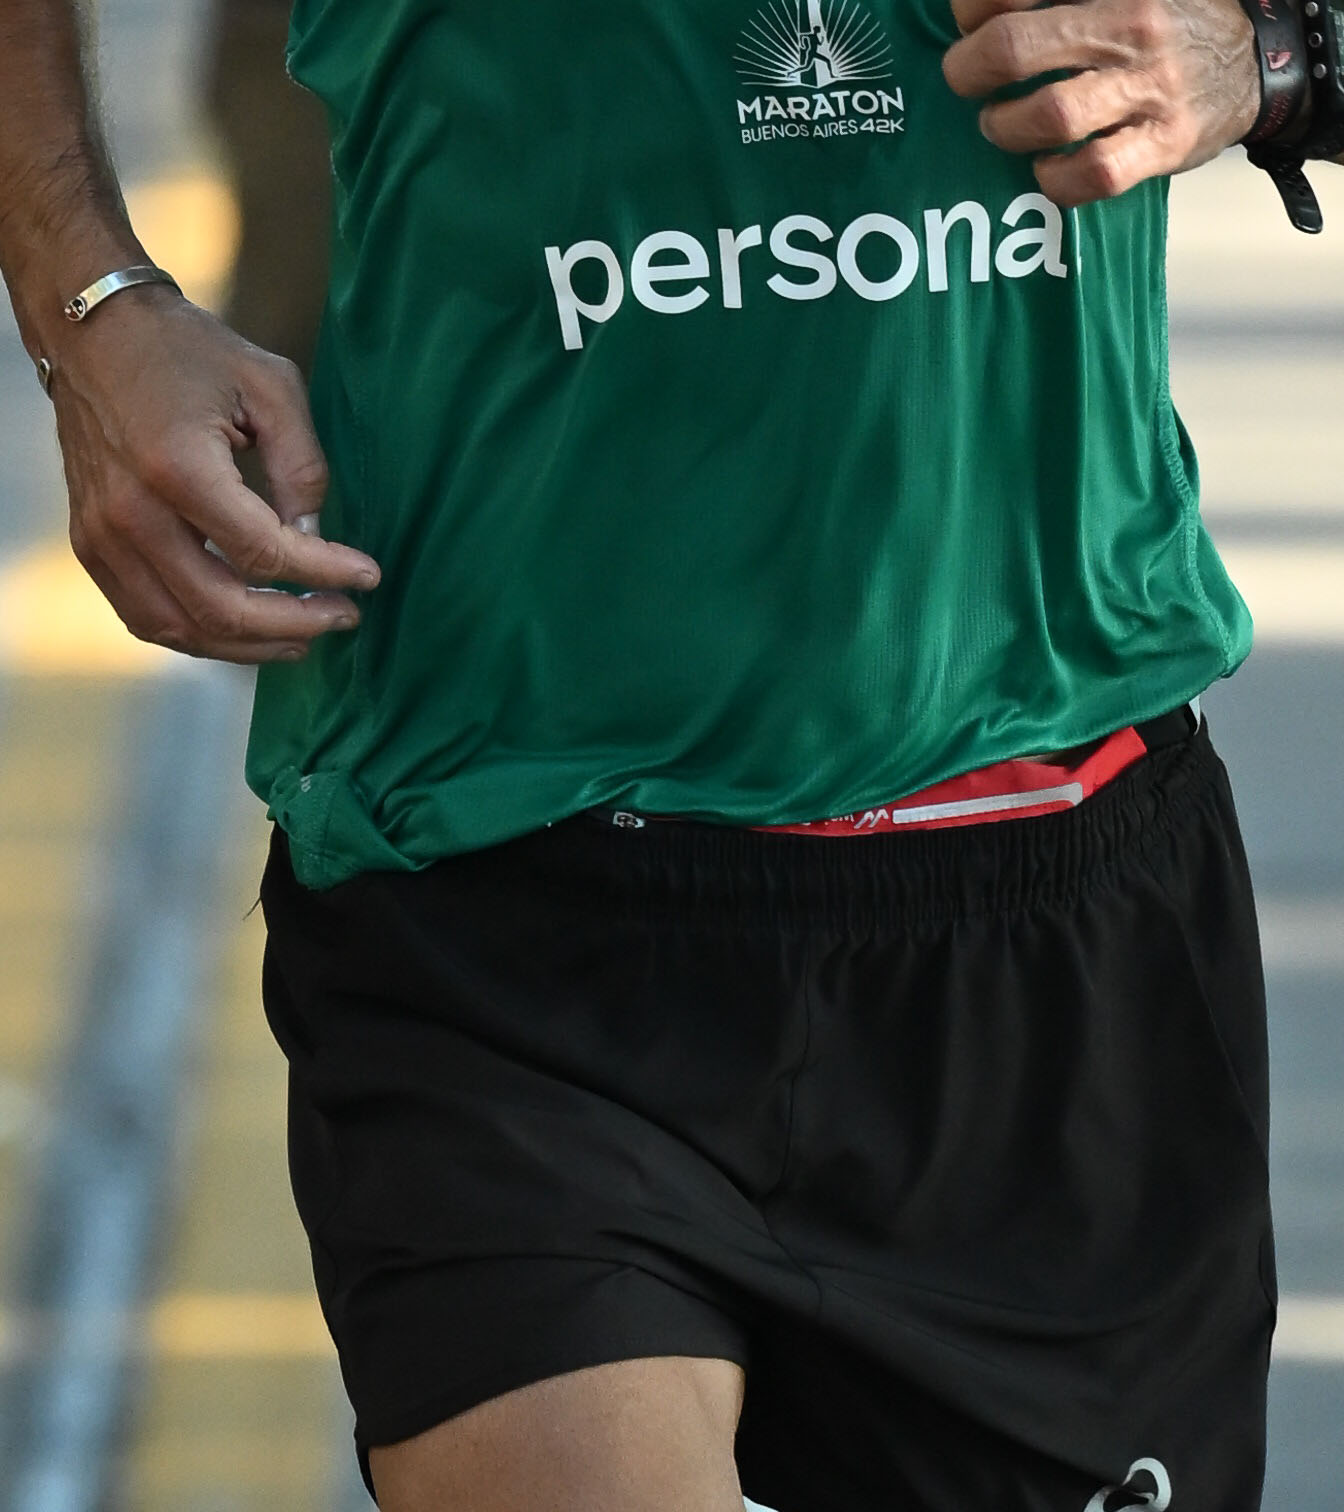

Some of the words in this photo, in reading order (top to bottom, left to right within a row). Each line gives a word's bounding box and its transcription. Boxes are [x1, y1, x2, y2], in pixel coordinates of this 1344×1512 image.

[737, 86, 905, 125] MARATON
[741, 123, 810, 144] BUENOS
[812, 119, 859, 139] AIRES
[859, 118, 905, 134] 42K
[544, 192, 1082, 351] persona
